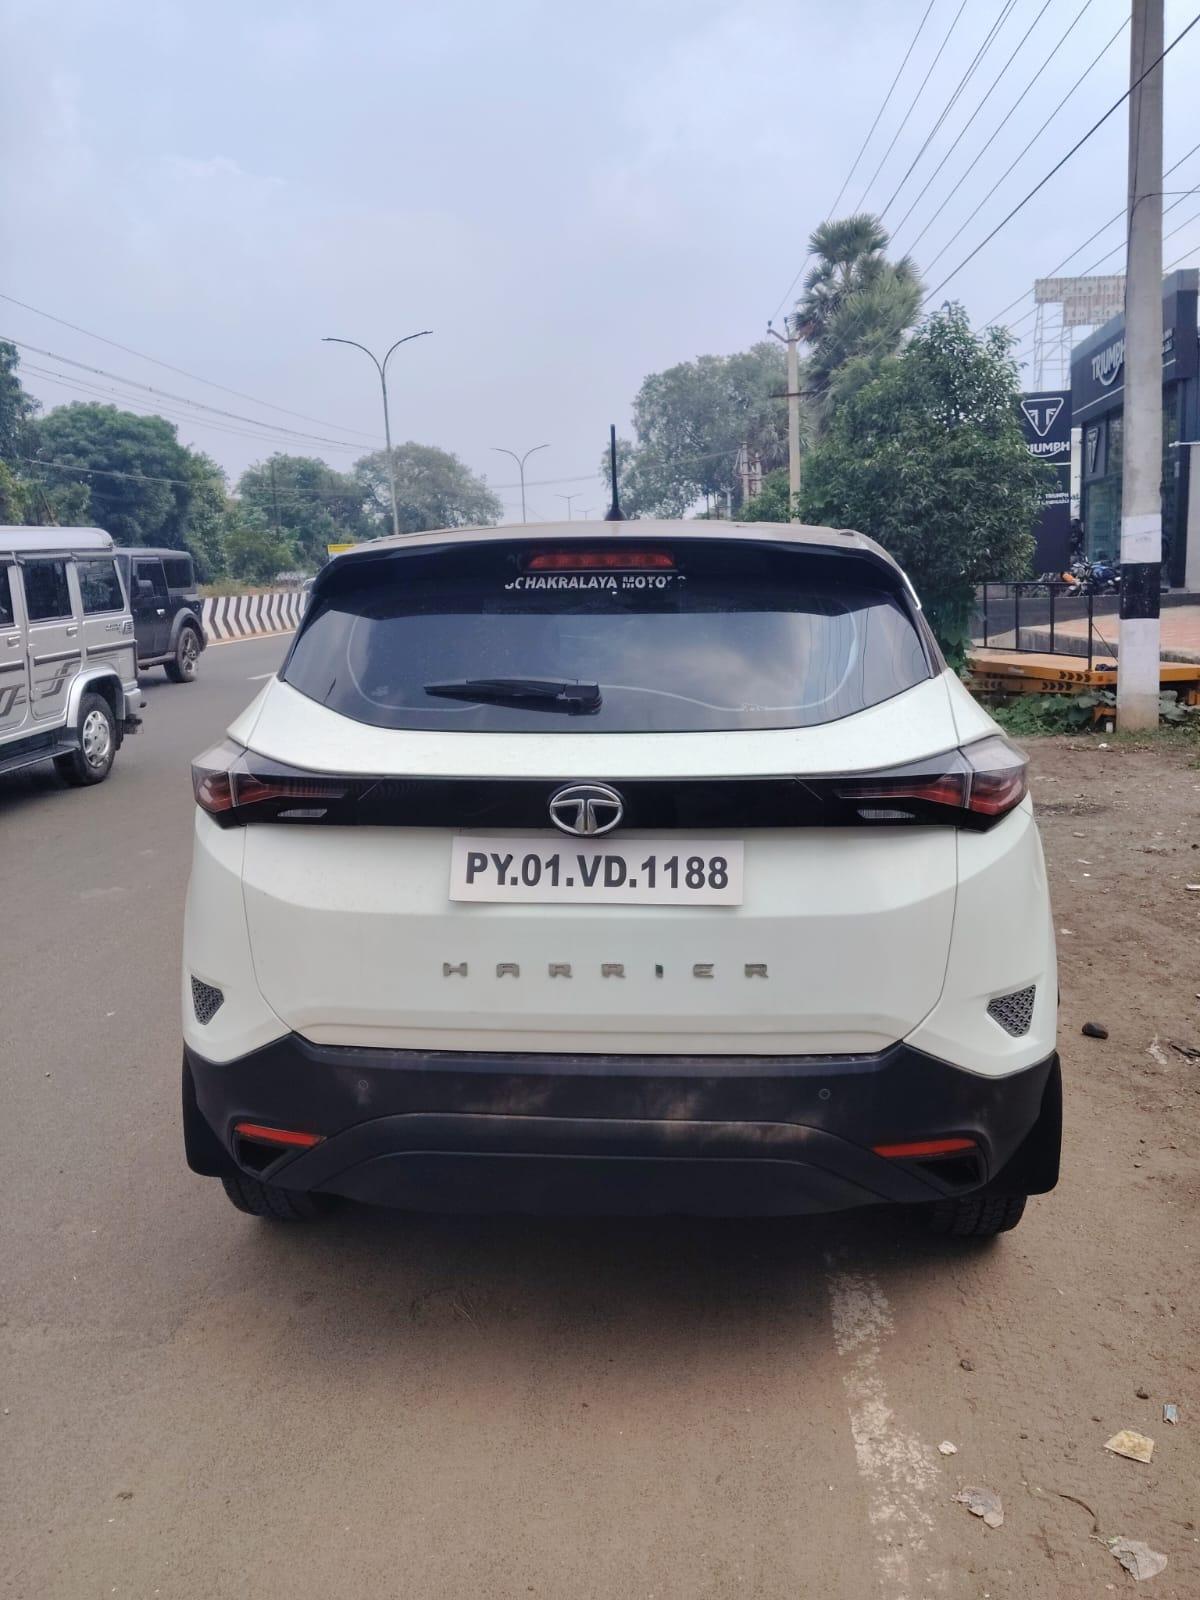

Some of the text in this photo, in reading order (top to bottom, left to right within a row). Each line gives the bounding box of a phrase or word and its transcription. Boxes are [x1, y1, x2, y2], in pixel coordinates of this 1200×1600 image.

[1026, 441, 1070, 455] IUMPH
[622, 576, 686, 589] MOTO
[466, 852, 728, 889] PY.01.VD.1188
[443, 962, 768, 978] HARRIER
